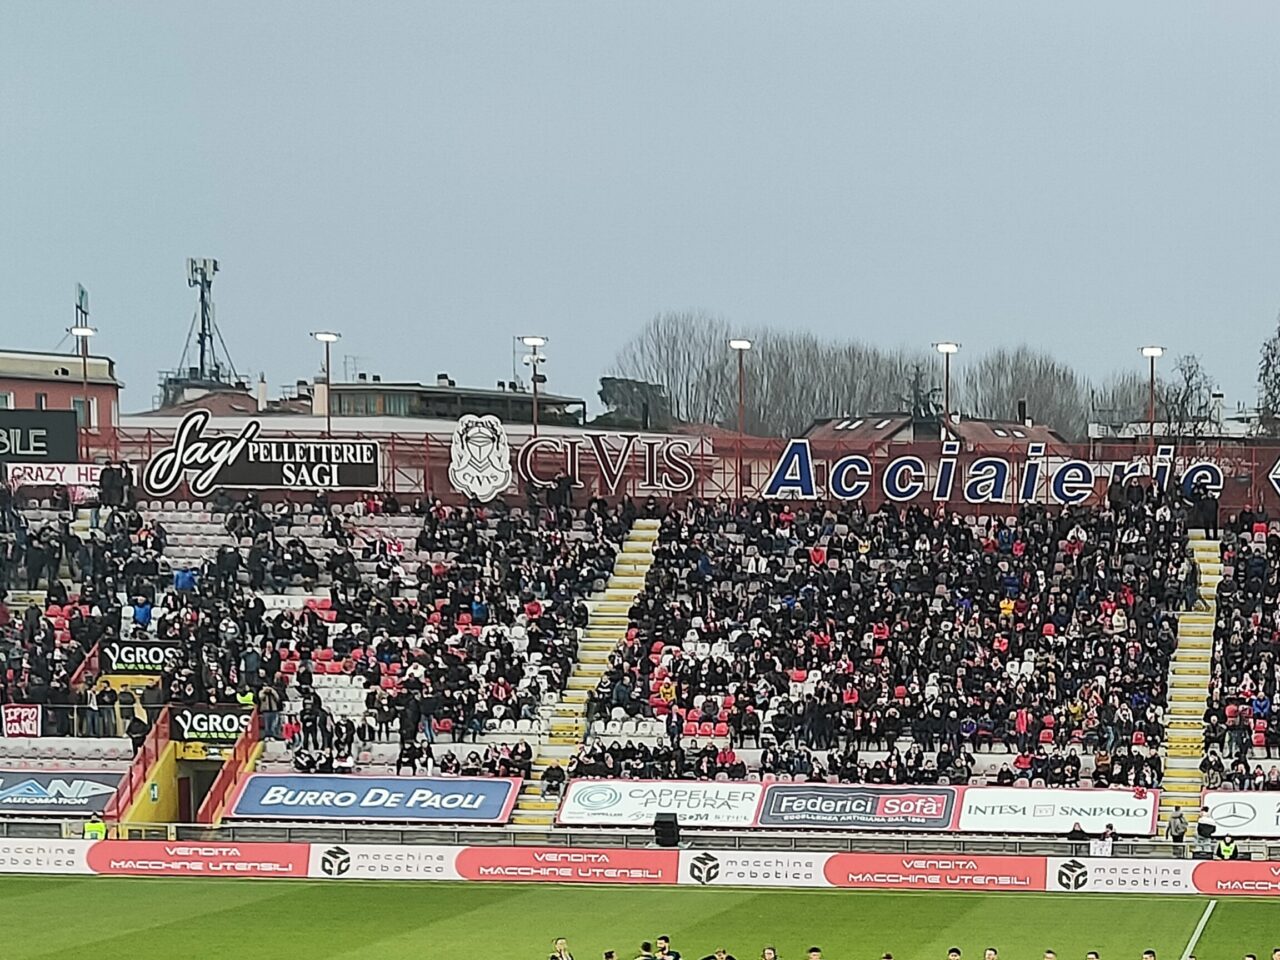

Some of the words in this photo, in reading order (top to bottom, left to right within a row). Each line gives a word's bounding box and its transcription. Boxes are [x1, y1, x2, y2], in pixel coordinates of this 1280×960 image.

[149, 413, 258, 490] Sagi
[249, 442, 374, 464] PELLETTERIE
[518, 433, 696, 494] CIVIS
[11, 466, 66, 481] CRAZY
[282, 464, 340, 486] SAGI
[762, 438, 1225, 503] Acciaierie
[462, 471, 499, 487] CIVIS
[260, 786, 358, 807] BURRO
[406, 790, 486, 810] PAOLI
[628, 788, 756, 802] CAPPELLER
[642, 799, 734, 810] FUTURA
[780, 796, 873, 813] Federici
[883, 797, 938, 815] Sofà
[967, 805, 1027, 816] INTESA
[1058, 806, 1148, 818] SANPAOLO
[0, 846, 76, 855] acchine
[165, 846, 241, 857] VENDITA
[356, 851, 445, 862] macchine
[533, 853, 610, 864] VENDITA
[725, 858, 814, 869] macchine
[902, 859, 978, 870] VENDITA
[110, 860, 204, 872] MACCHINE
[208, 861, 293, 873] UTENSILI
[355, 864, 445, 874] robotica
[479, 866, 575, 877] MACCHINE
[577, 867, 663, 879] UTENSILI
[1093, 865, 1182, 876] macchine
[724, 869, 814, 880] robotica
[848, 873, 941, 884] MACCHINE
[945, 874, 1031, 885] UTENSILI
